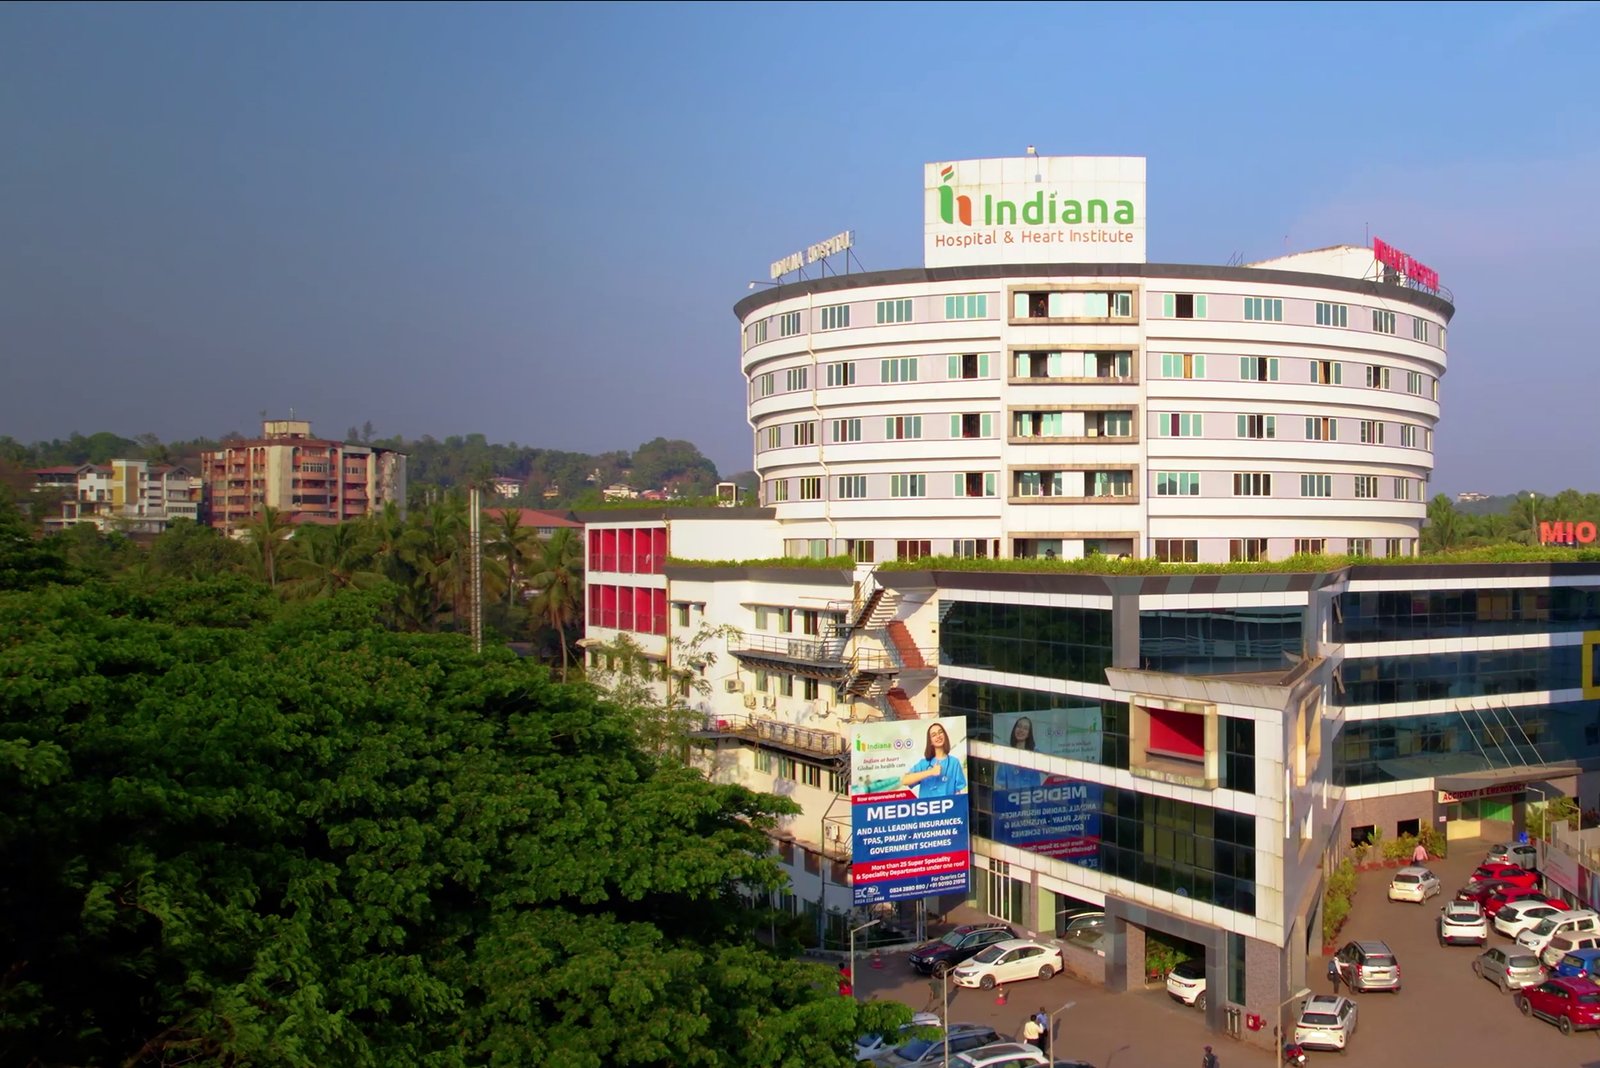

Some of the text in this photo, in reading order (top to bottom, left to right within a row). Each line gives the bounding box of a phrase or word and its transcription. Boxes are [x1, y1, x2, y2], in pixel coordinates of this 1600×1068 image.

[985, 190, 1134, 225] Indiana
[935, 229, 1133, 248] Hospital & Heart Institute
[1540, 521, 1597, 543] MIO
[1443, 789, 1478, 801] ACCIDENT
[867, 799, 954, 821] MEDISEP
[857, 828, 872, 836] AND
[888, 822, 918, 832] LEADING
[919, 817, 963, 828] INSURANCES,
[863, 837, 883, 846] TPAS,
[884, 834, 907, 843] PMJAY
[912, 829, 951, 840] AYUSHMAN
[869, 838, 952, 855] GOVERNMENT SCHEMES
[907, 860, 924, 868] Super
[924, 855, 951, 865] Speciality
[861, 870, 889, 881] Speciality
[889, 865, 926, 877] Departments
[926, 863, 942, 871] under
